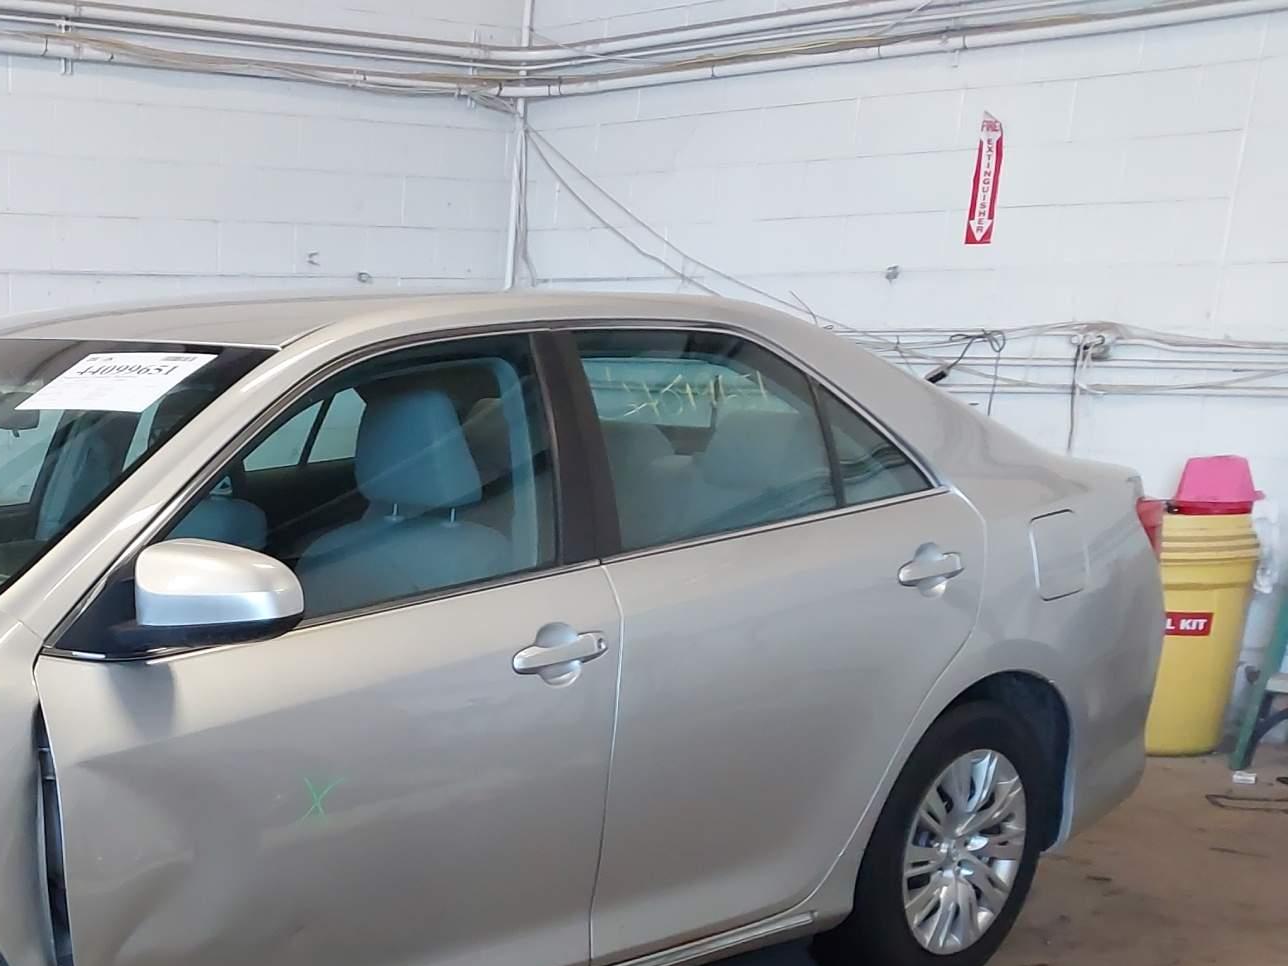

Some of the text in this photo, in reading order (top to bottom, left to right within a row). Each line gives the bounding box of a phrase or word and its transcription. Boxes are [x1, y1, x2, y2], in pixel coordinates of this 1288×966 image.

[981, 120, 999, 132] FIRE
[976, 138, 993, 233] EXTINGUISHER
[77, 364, 179, 376] 44099651
[1179, 618, 1208, 630] KIT
